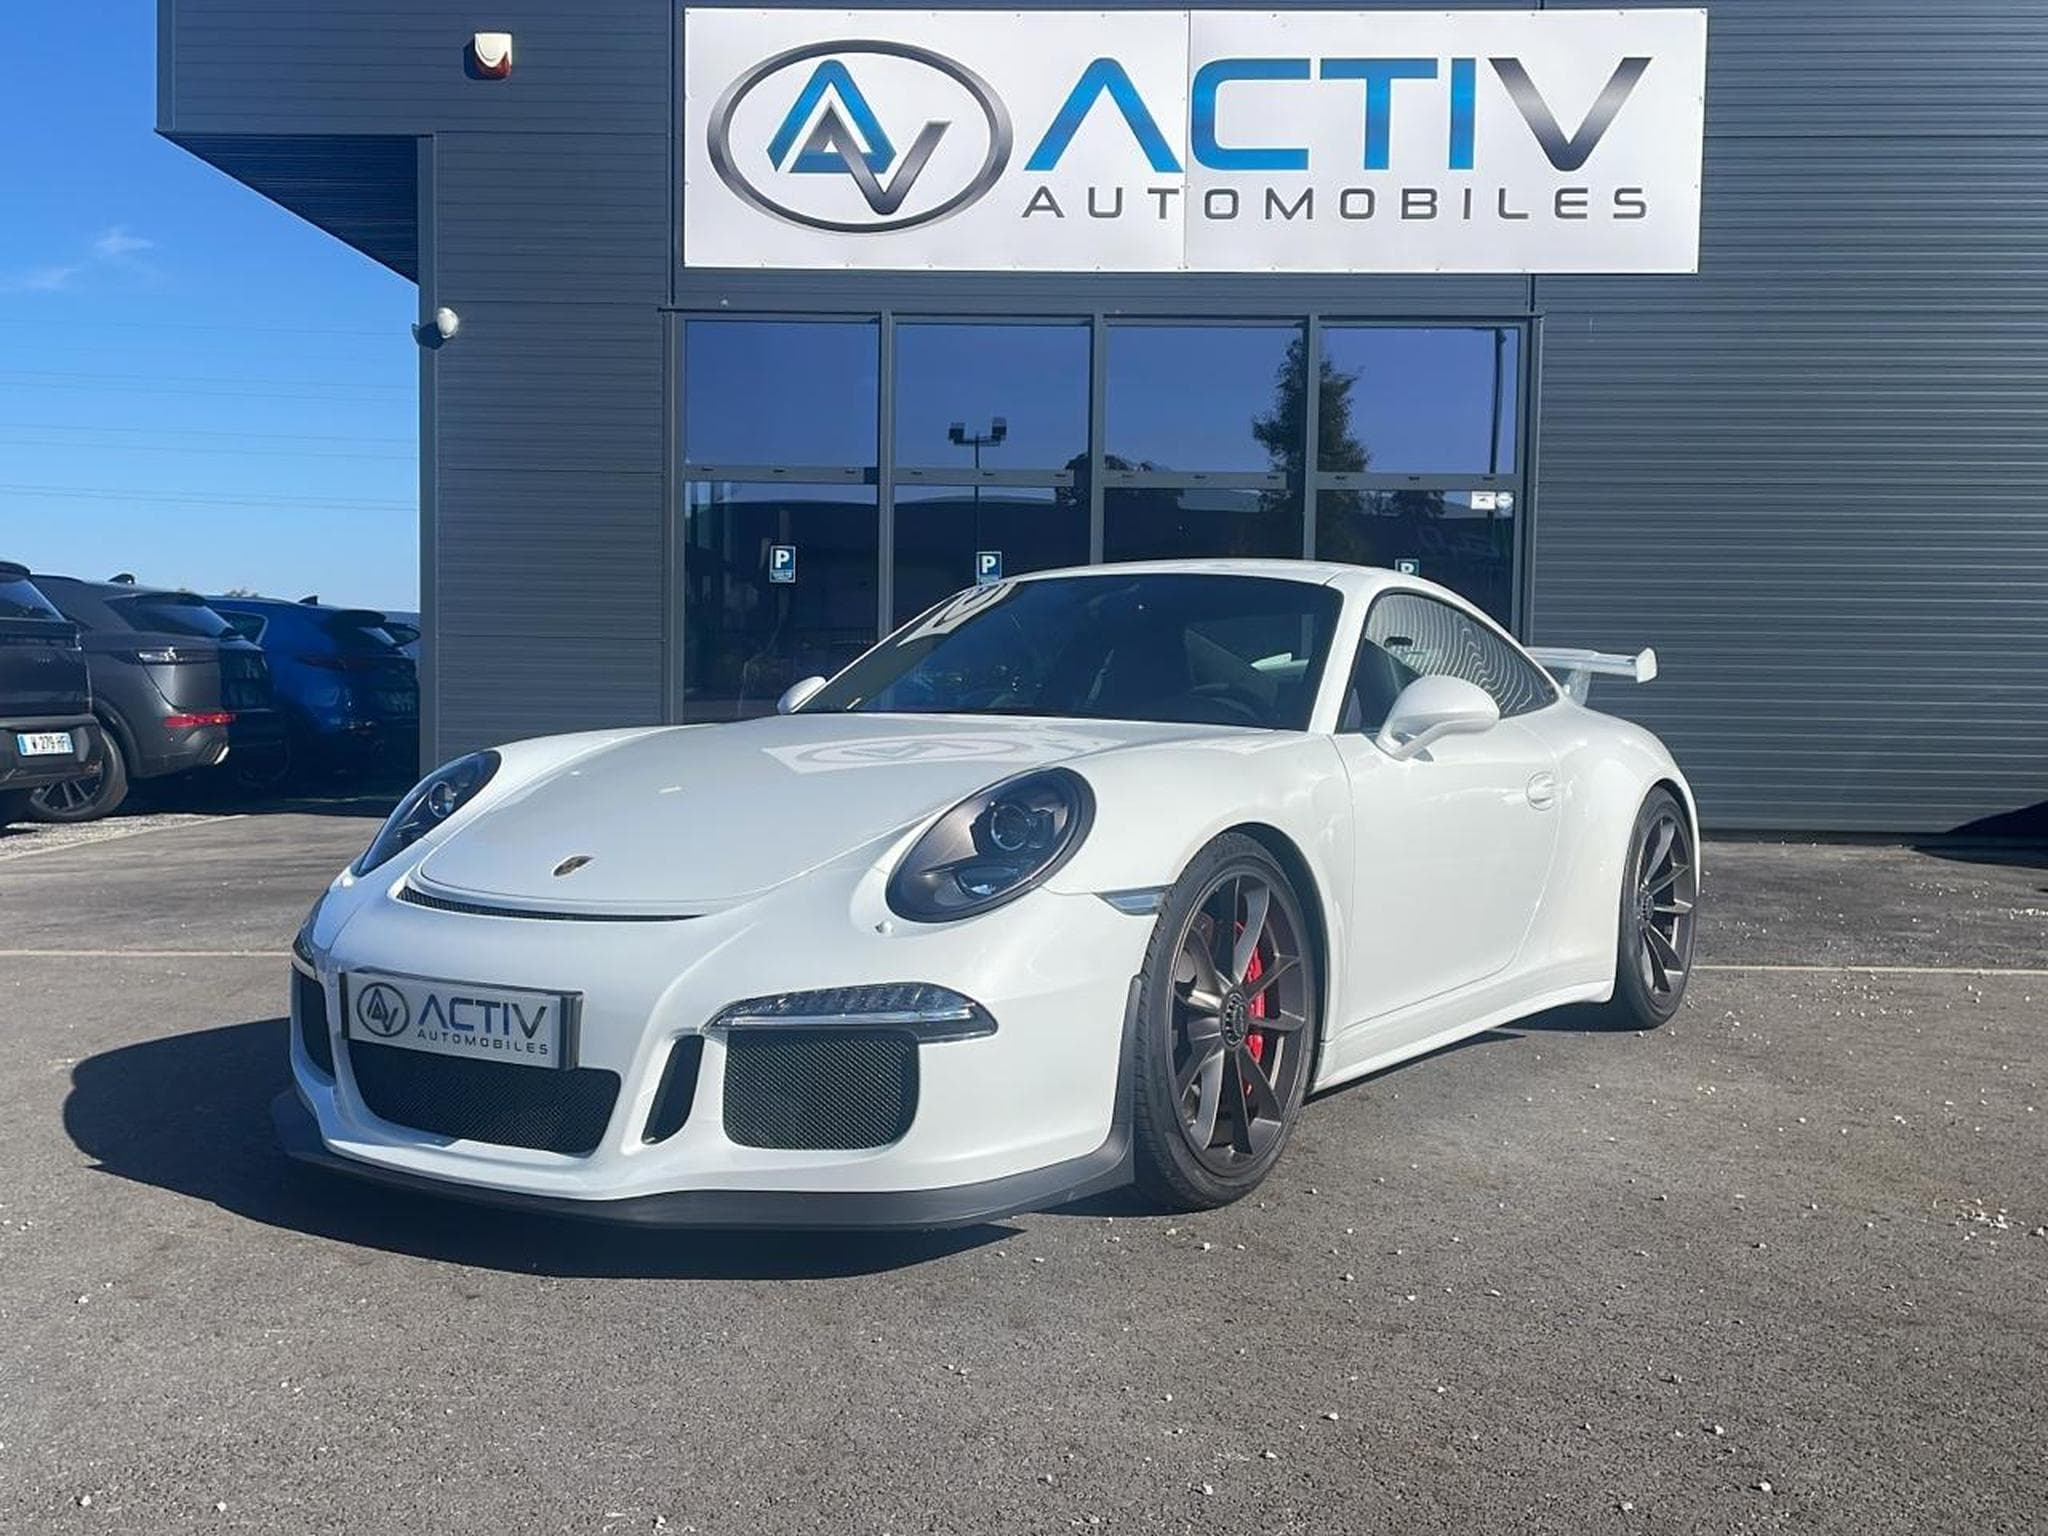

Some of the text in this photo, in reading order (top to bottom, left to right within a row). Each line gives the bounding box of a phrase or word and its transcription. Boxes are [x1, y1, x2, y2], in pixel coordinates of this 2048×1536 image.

[1023, 57, 1653, 173] ACTIV
[1021, 185, 1648, 220] AUTOMOBILES
[775, 550, 790, 568] P
[981, 555, 996, 573] P
[418, 993, 548, 1040] ACTIV
[417, 1029, 548, 1055] AUTOMOBILES
